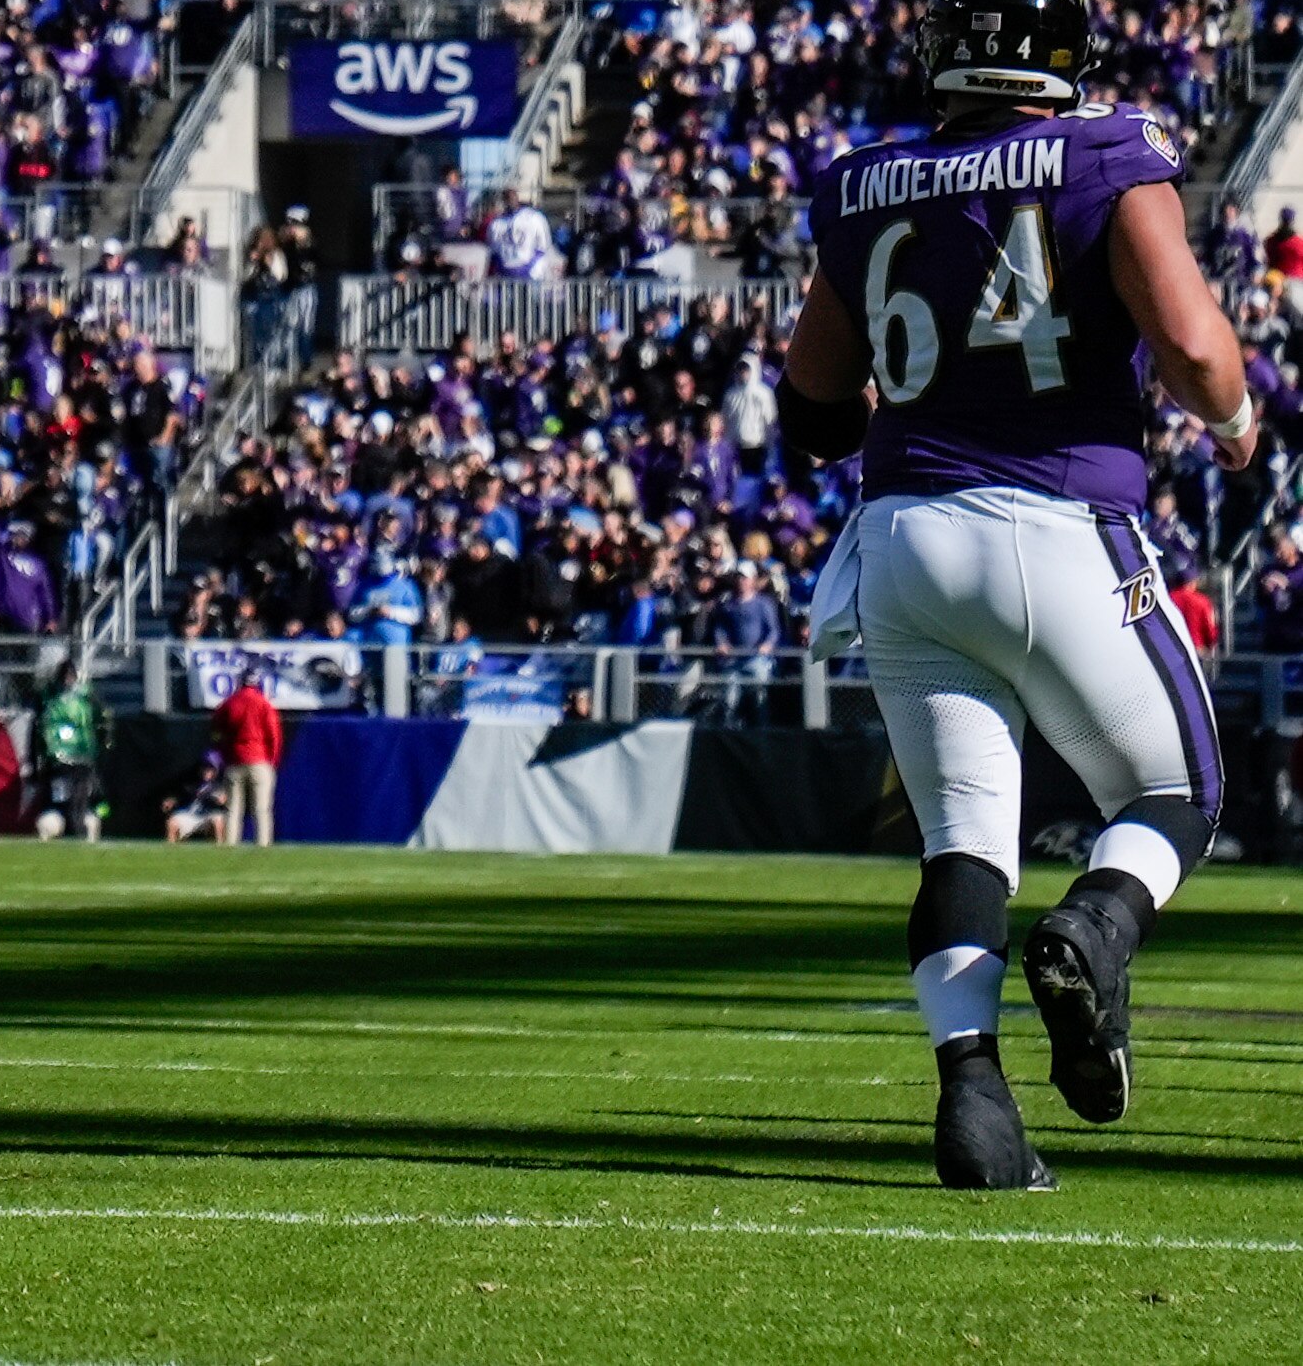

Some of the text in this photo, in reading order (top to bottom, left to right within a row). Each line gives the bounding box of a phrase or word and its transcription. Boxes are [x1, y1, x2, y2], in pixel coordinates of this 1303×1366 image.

[335, 42, 473, 95] aws
[840, 137, 1066, 218] LINDERBAUM
[864, 203, 1073, 404] 64
